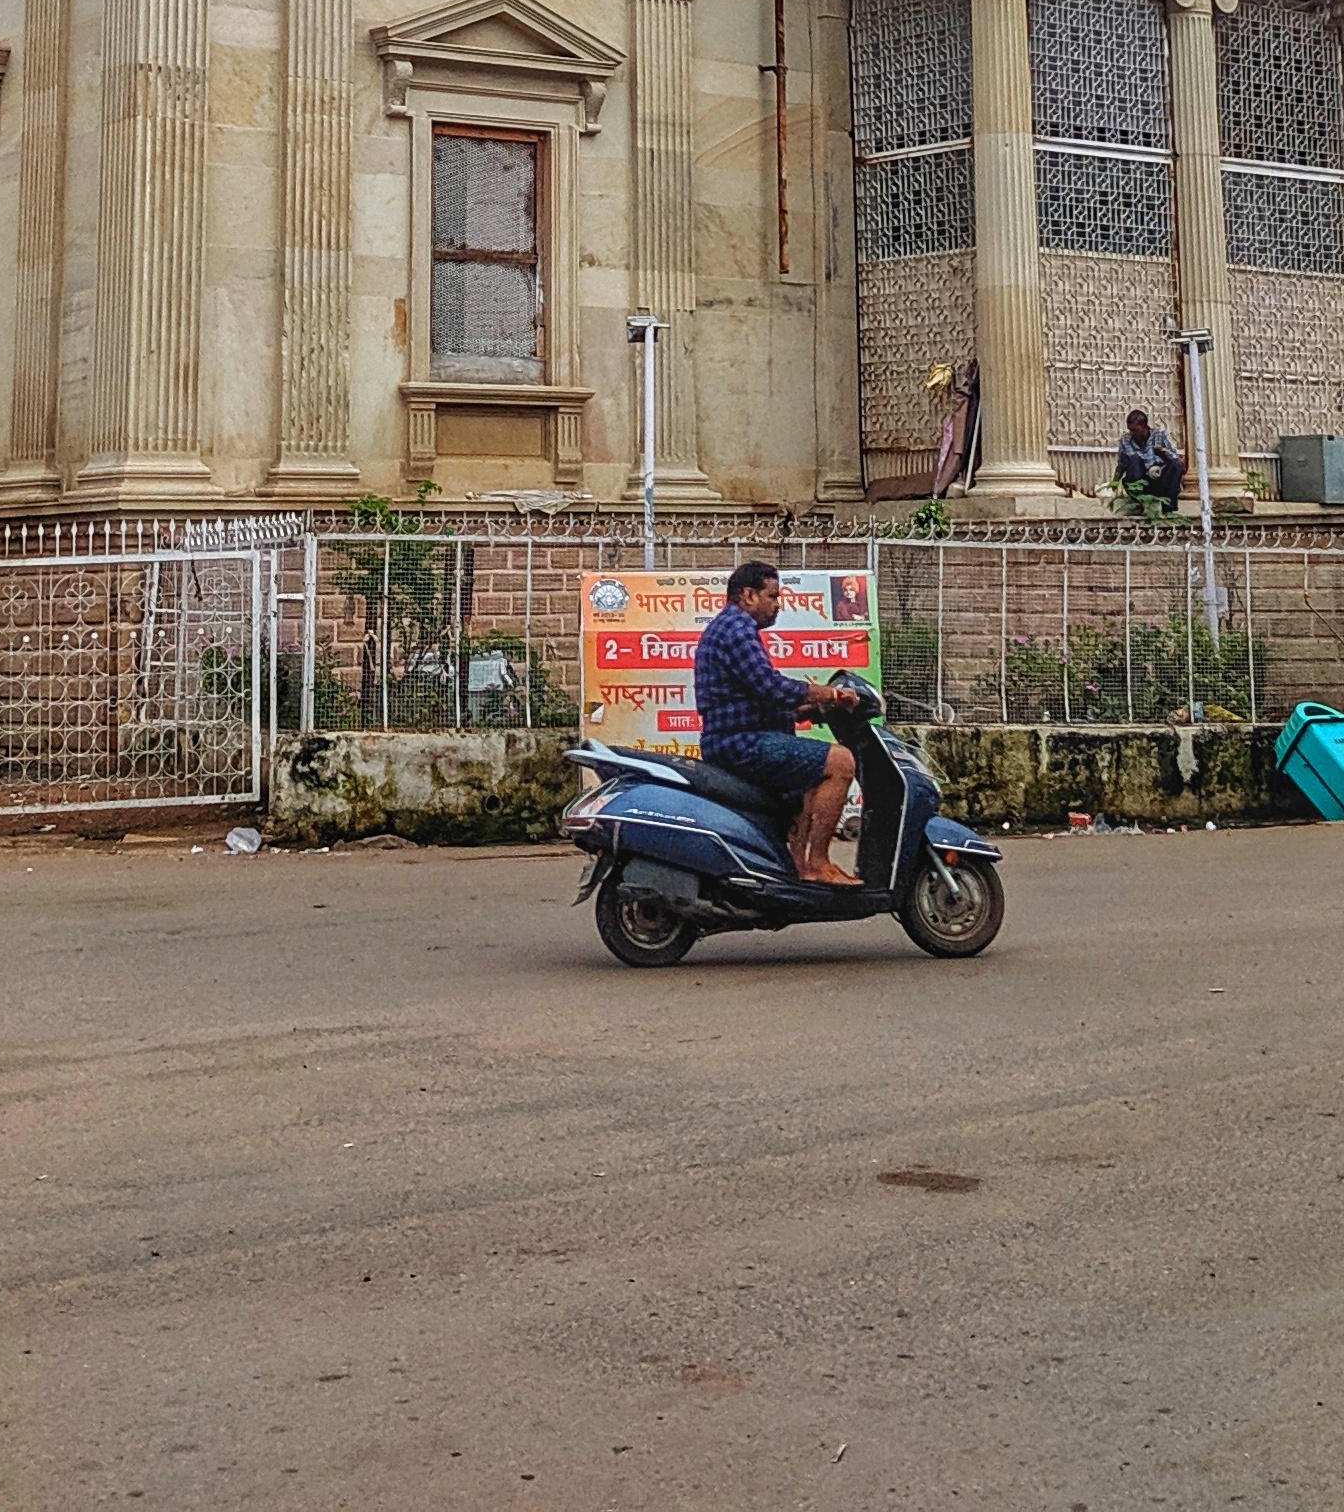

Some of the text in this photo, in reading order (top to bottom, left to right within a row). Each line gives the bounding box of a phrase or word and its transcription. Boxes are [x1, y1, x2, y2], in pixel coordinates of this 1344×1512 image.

[635, 593, 686, 613] भारत
[777, 586, 828, 620] रिषद्
[767, 633, 795, 658] के
[800, 639, 848, 658] नाम
[600, 685, 686, 711] राष्ट्रगान
